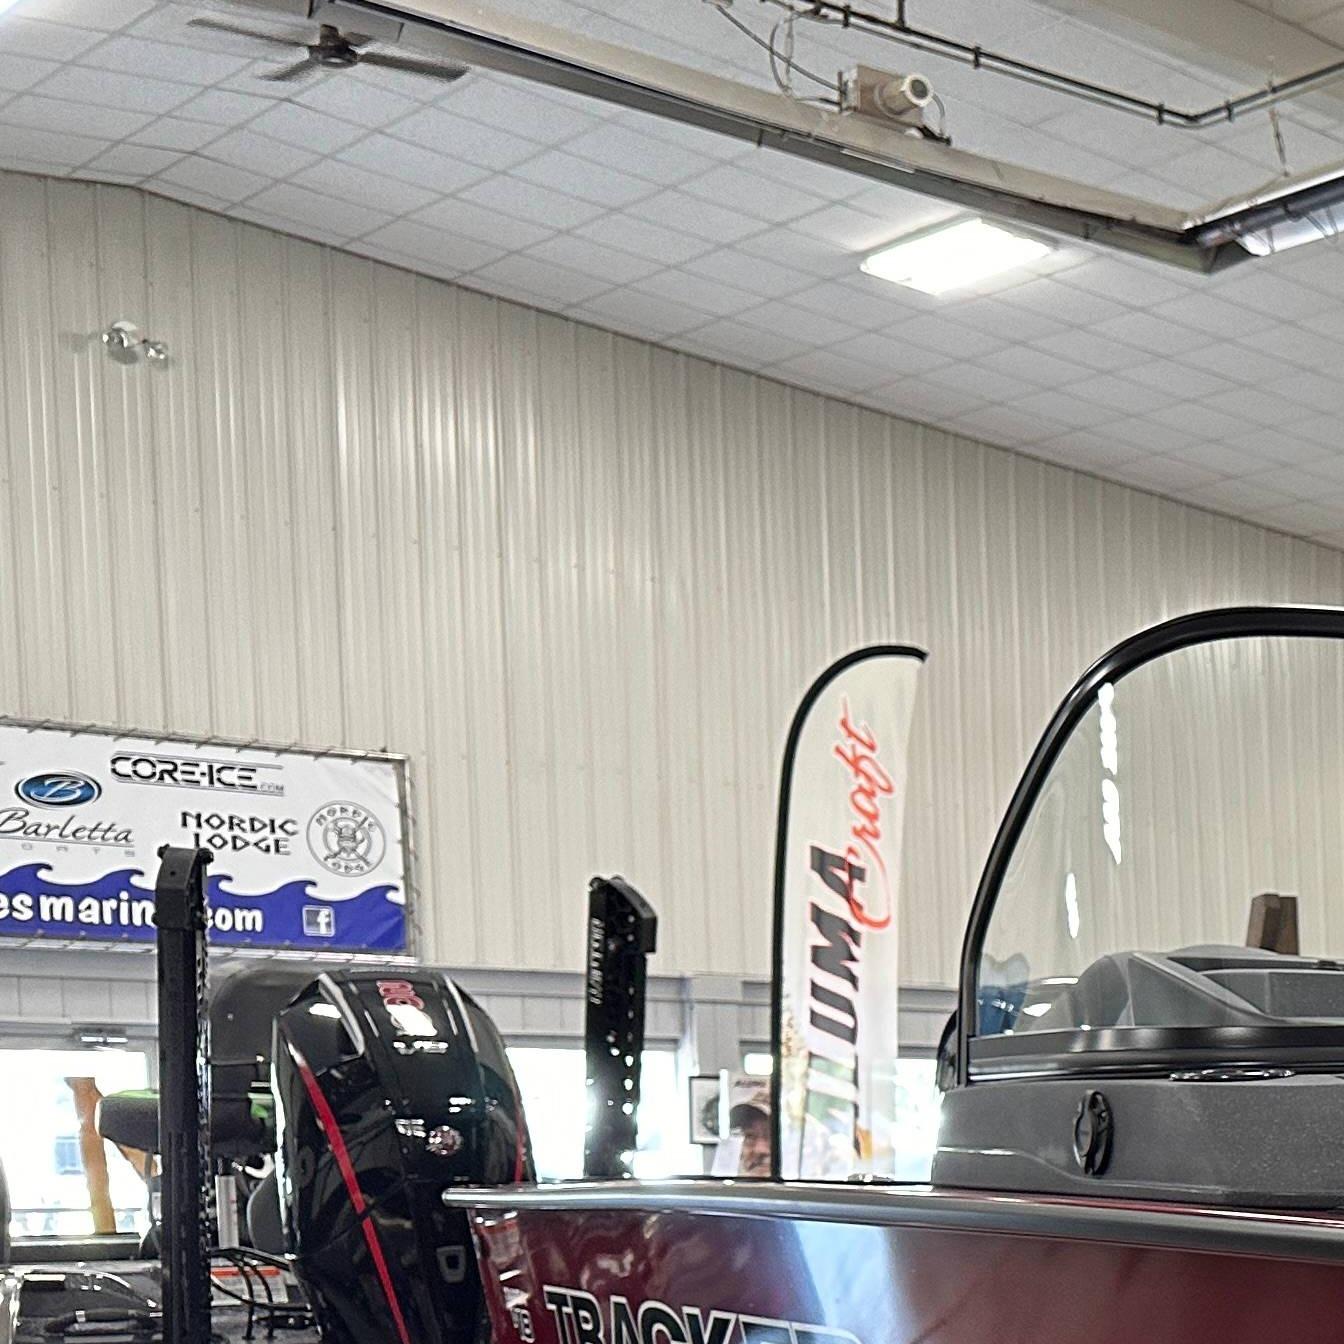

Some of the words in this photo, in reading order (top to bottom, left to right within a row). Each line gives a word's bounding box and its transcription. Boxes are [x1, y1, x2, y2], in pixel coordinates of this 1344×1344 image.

[111, 756, 257, 789] CORE-ICE
[0, 807, 133, 844] Barletta
[181, 811, 299, 836] NORDIC
